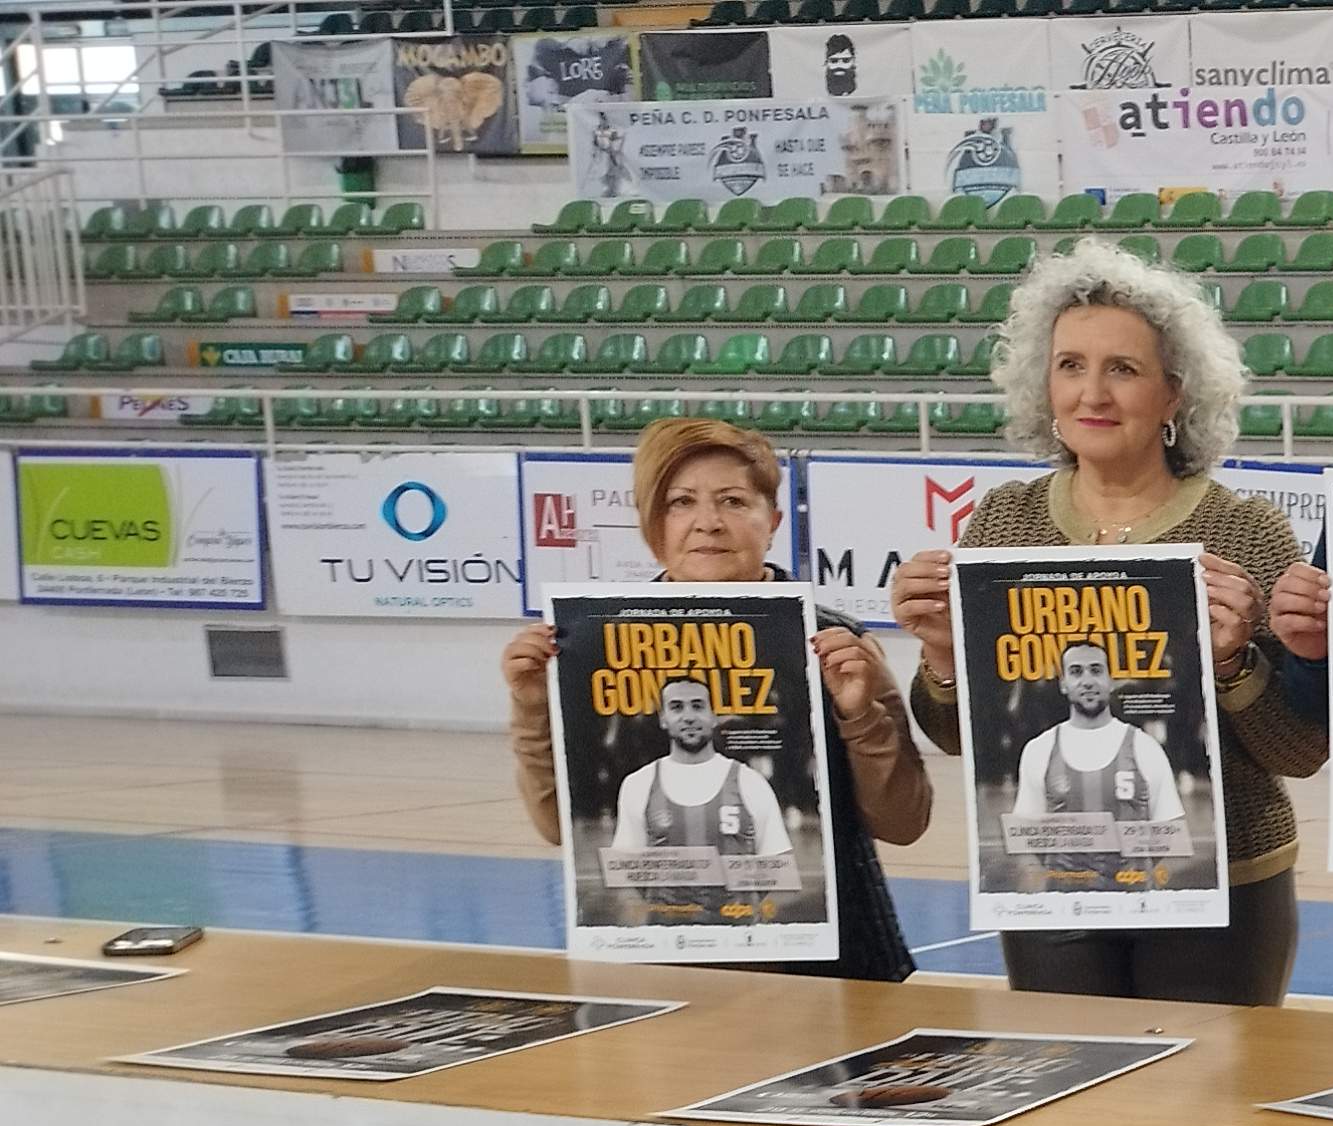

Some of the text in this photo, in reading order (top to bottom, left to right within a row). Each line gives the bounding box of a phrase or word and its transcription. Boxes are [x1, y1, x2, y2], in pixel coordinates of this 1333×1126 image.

[1194, 60, 1331, 86] sanyclima
[629, 109, 676, 126] PEÑA
[724, 106, 830, 123] PONFESALA
[1118, 88, 1306, 132] atiendo
[1273, 131, 1306, 143] León
[49, 518, 162, 542] CUEVAS
[319, 552, 523, 585] TU VISIÓN
[1007, 584, 1150, 635] URBANO
[603, 622, 757, 670] URBANO
[1114, 770, 1136, 800] 5
[719, 804, 741, 836] 5
